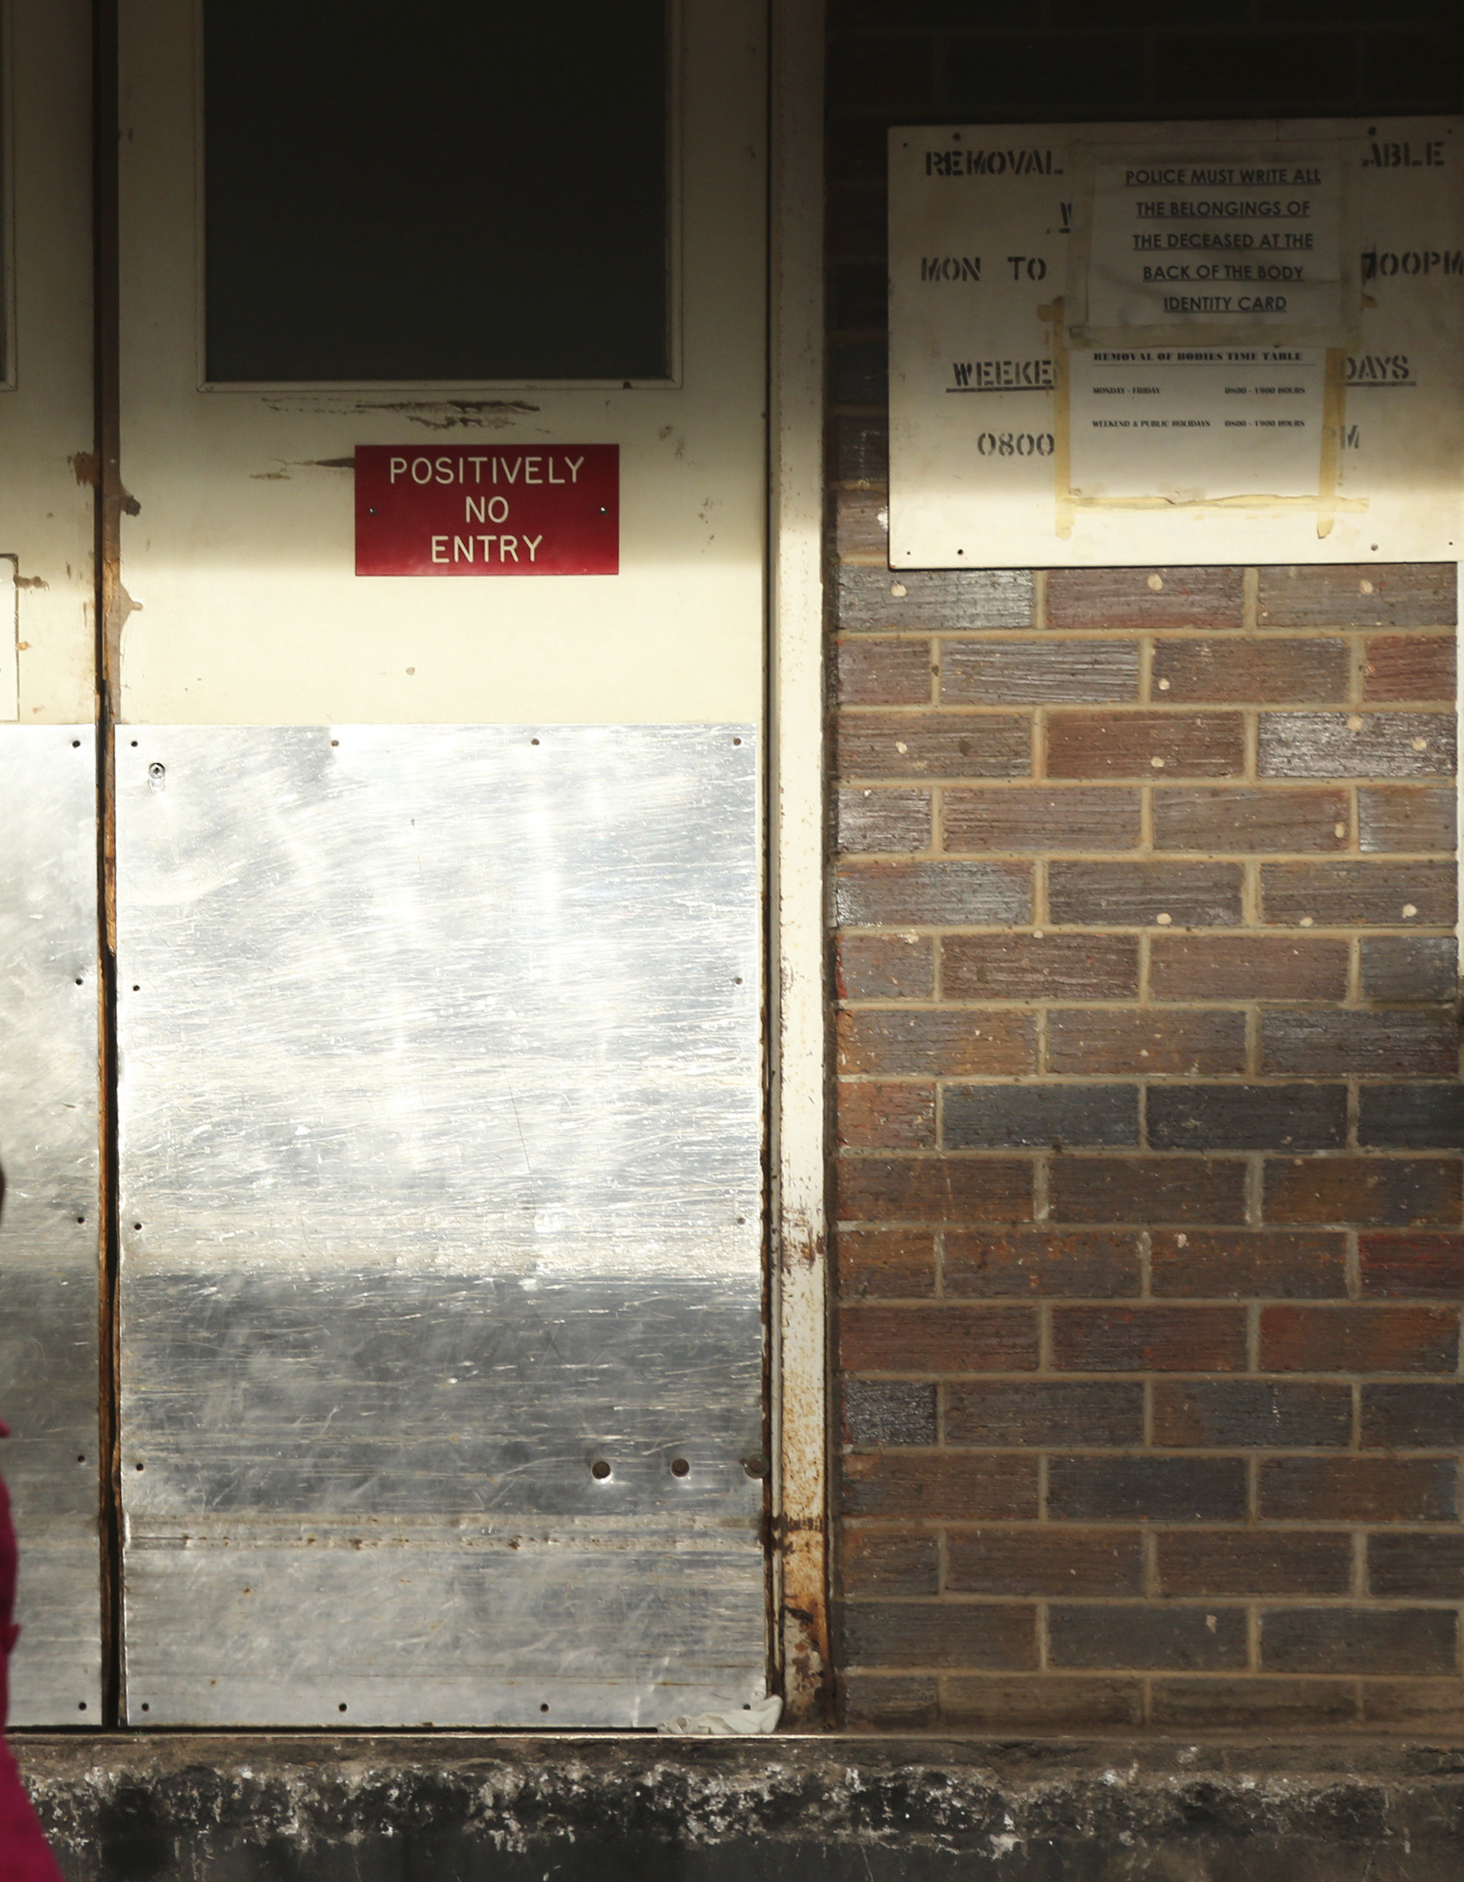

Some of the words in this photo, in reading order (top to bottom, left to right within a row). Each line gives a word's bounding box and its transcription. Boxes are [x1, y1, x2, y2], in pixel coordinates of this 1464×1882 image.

[925, 149, 1064, 177] REMOVAL
[1126, 169, 1186, 185] POLICE
[1191, 168, 1234, 184] MUST
[1240, 168, 1288, 183] WRITE
[1293, 168, 1321, 183] ALL
[1136, 201, 1165, 216] THE
[1170, 200, 1281, 216] BELONGINGS
[1286, 200, 1311, 215] OF
[1132, 233, 1162, 249] THE
[1168, 233, 1254, 249] DECEASED
[1260, 233, 1282, 248] AT
[1285, 233, 1314, 248] THE
[921, 256, 981, 282] MON
[1007, 256, 1047, 281] TO
[1143, 265, 1189, 280] BACK
[1196, 265, 1220, 279] OF
[1225, 265, 1253, 279] THE
[1258, 265, 1304, 279] BODY
[1163, 296, 1233, 312] IDENTITY
[1238, 296, 1287, 311] CARD
[1092, 352, 1155, 362] REMOVAL
[1157, 352, 1174, 361] OF
[1177, 352, 1223, 361] BODIES
[1226, 352, 1259, 361] TIME
[1262, 352, 1303, 361] TABLE
[952, 360, 1056, 387] WEEKE
[1092, 386, 1126, 395] MONDAY
[1132, 386, 1161, 395] FRIDAY
[1277, 386, 1306, 394] HOURS
[1092, 419, 1131, 428] WEEKEND
[1140, 419, 1169, 428] PUBLIC
[1171, 419, 1211, 428] HOLIDAYS
[1277, 419, 1305, 427] HOURS
[977, 432, 1055, 456] 0800
[389, 456, 585, 485] POSITIVELY
[465, 495, 510, 524] NO
[431, 534, 544, 564] ENTRY
